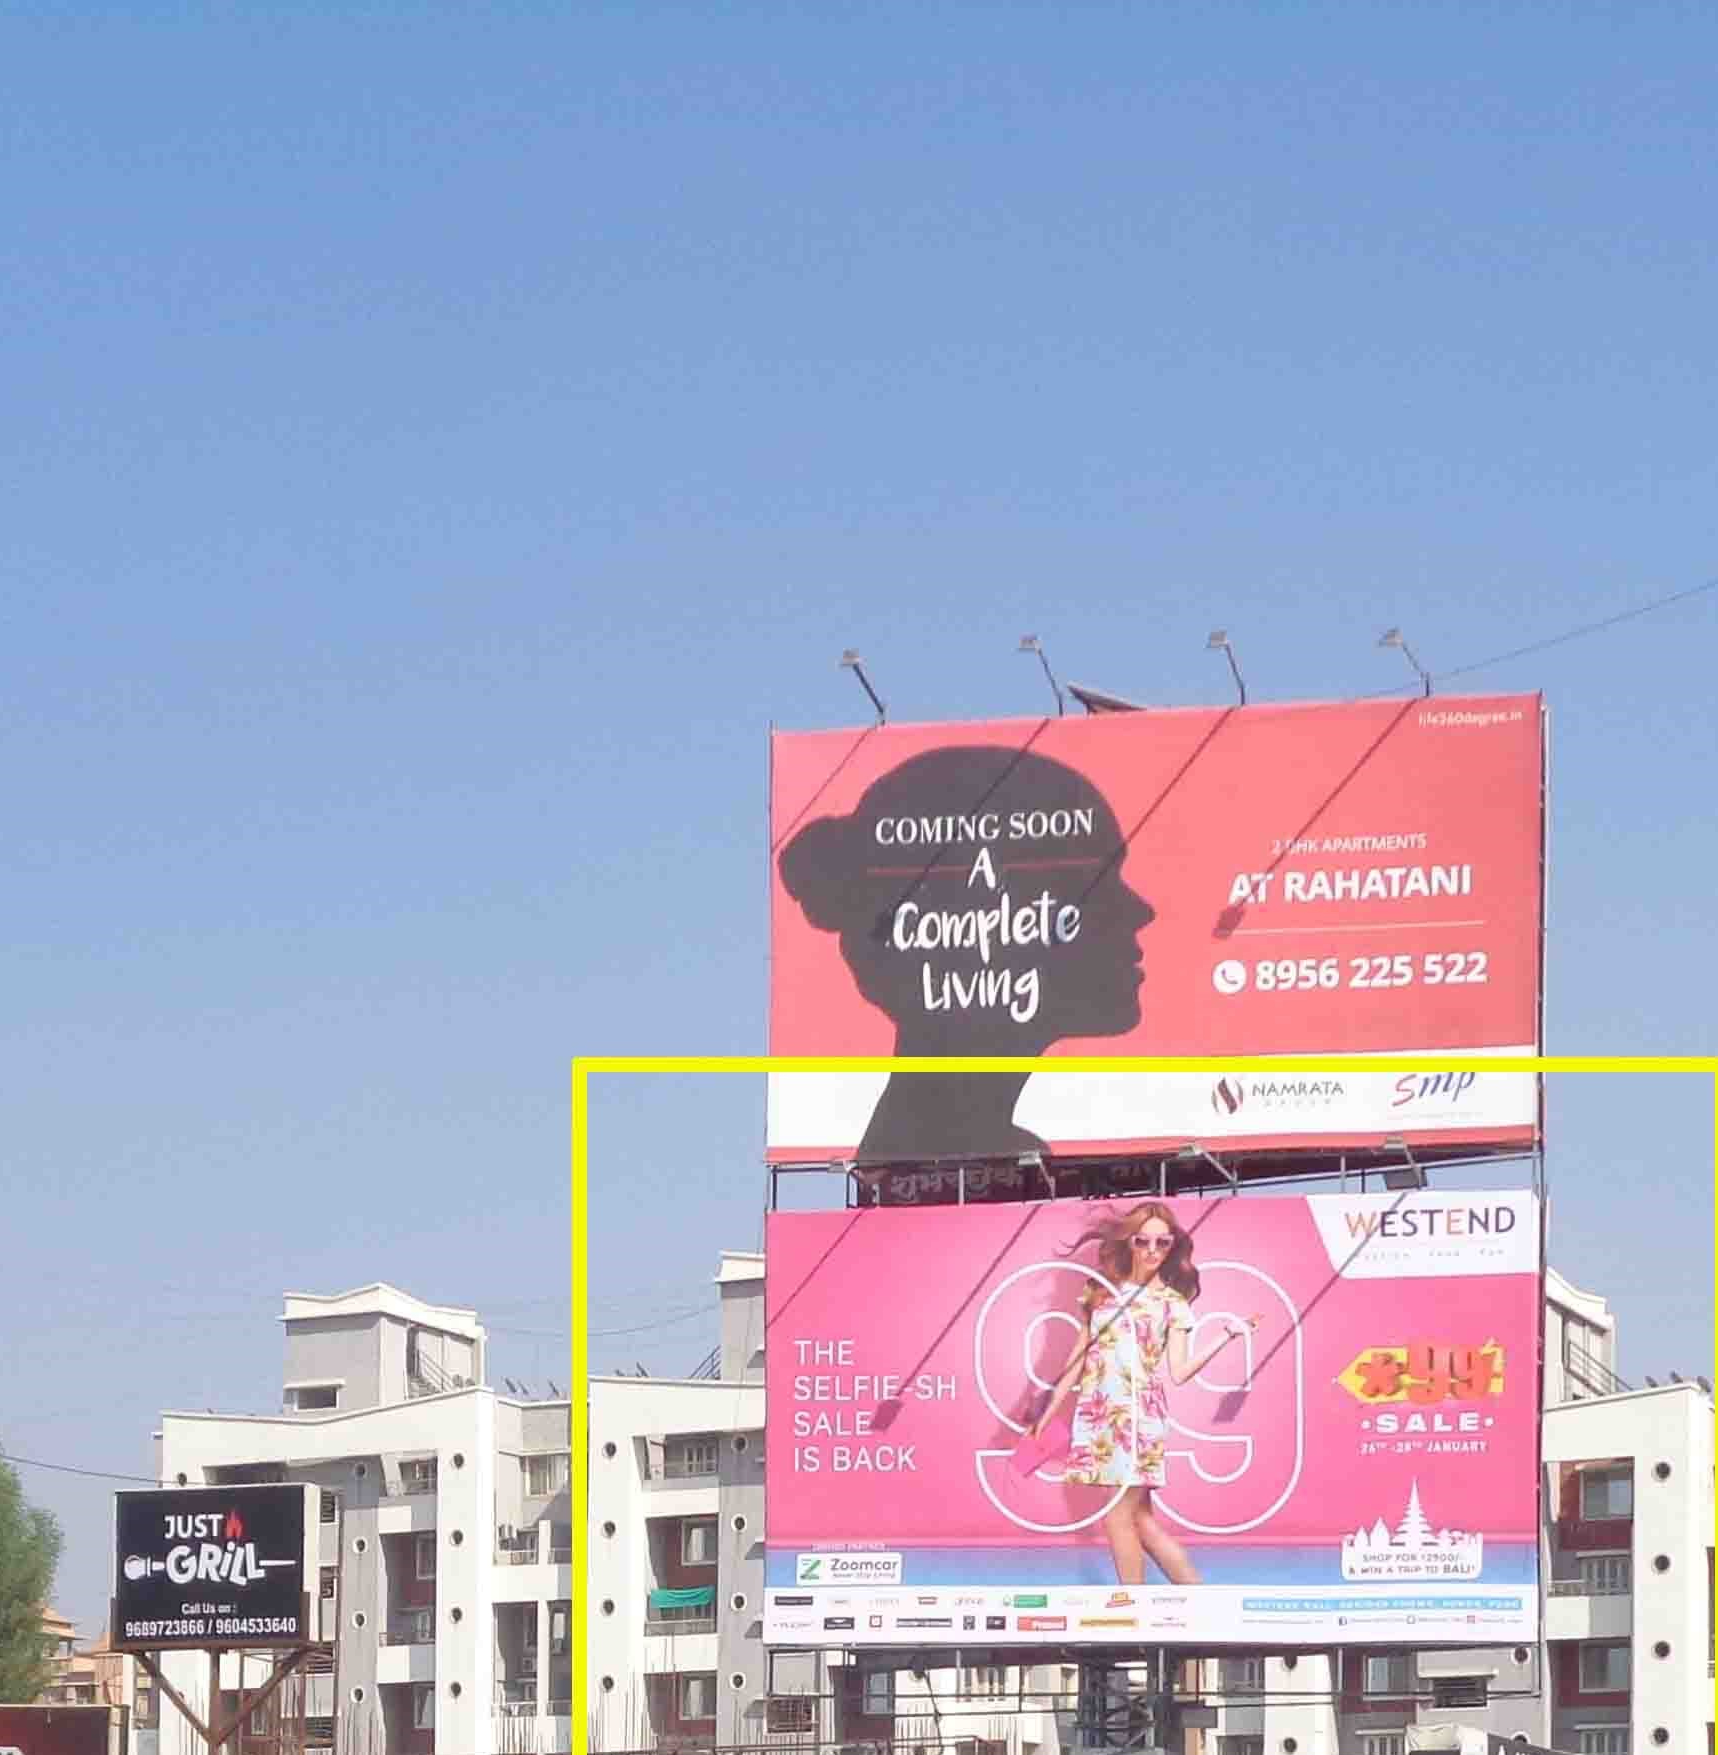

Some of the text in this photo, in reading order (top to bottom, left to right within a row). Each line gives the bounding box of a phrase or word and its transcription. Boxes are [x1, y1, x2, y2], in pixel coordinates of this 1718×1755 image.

[875, 808, 1094, 845] COMING SOON
[1322, 833, 1427, 852] APARTMENTS
[968, 847, 996, 888] A
[1228, 864, 1472, 905] AT RAHATANI
[892, 890, 1081, 964] Complete
[1255, 951, 1489, 991] 8956 225 522
[1251, 1081, 1345, 1097] NAMRATA
[1344, 1207, 1516, 1238] WESTEND
[794, 1339, 854, 1366] THE
[794, 1411, 873, 1436] SALE
[1376, 1411, 1480, 1434] SALE
[794, 1446, 917, 1472] IS BACK
[1427, 1439, 1487, 1454] JANUARY
[164, 1513, 224, 1540] JUST
[830, 1558, 898, 1572] Zoomcar
[181, 1603, 201, 1615] Call
